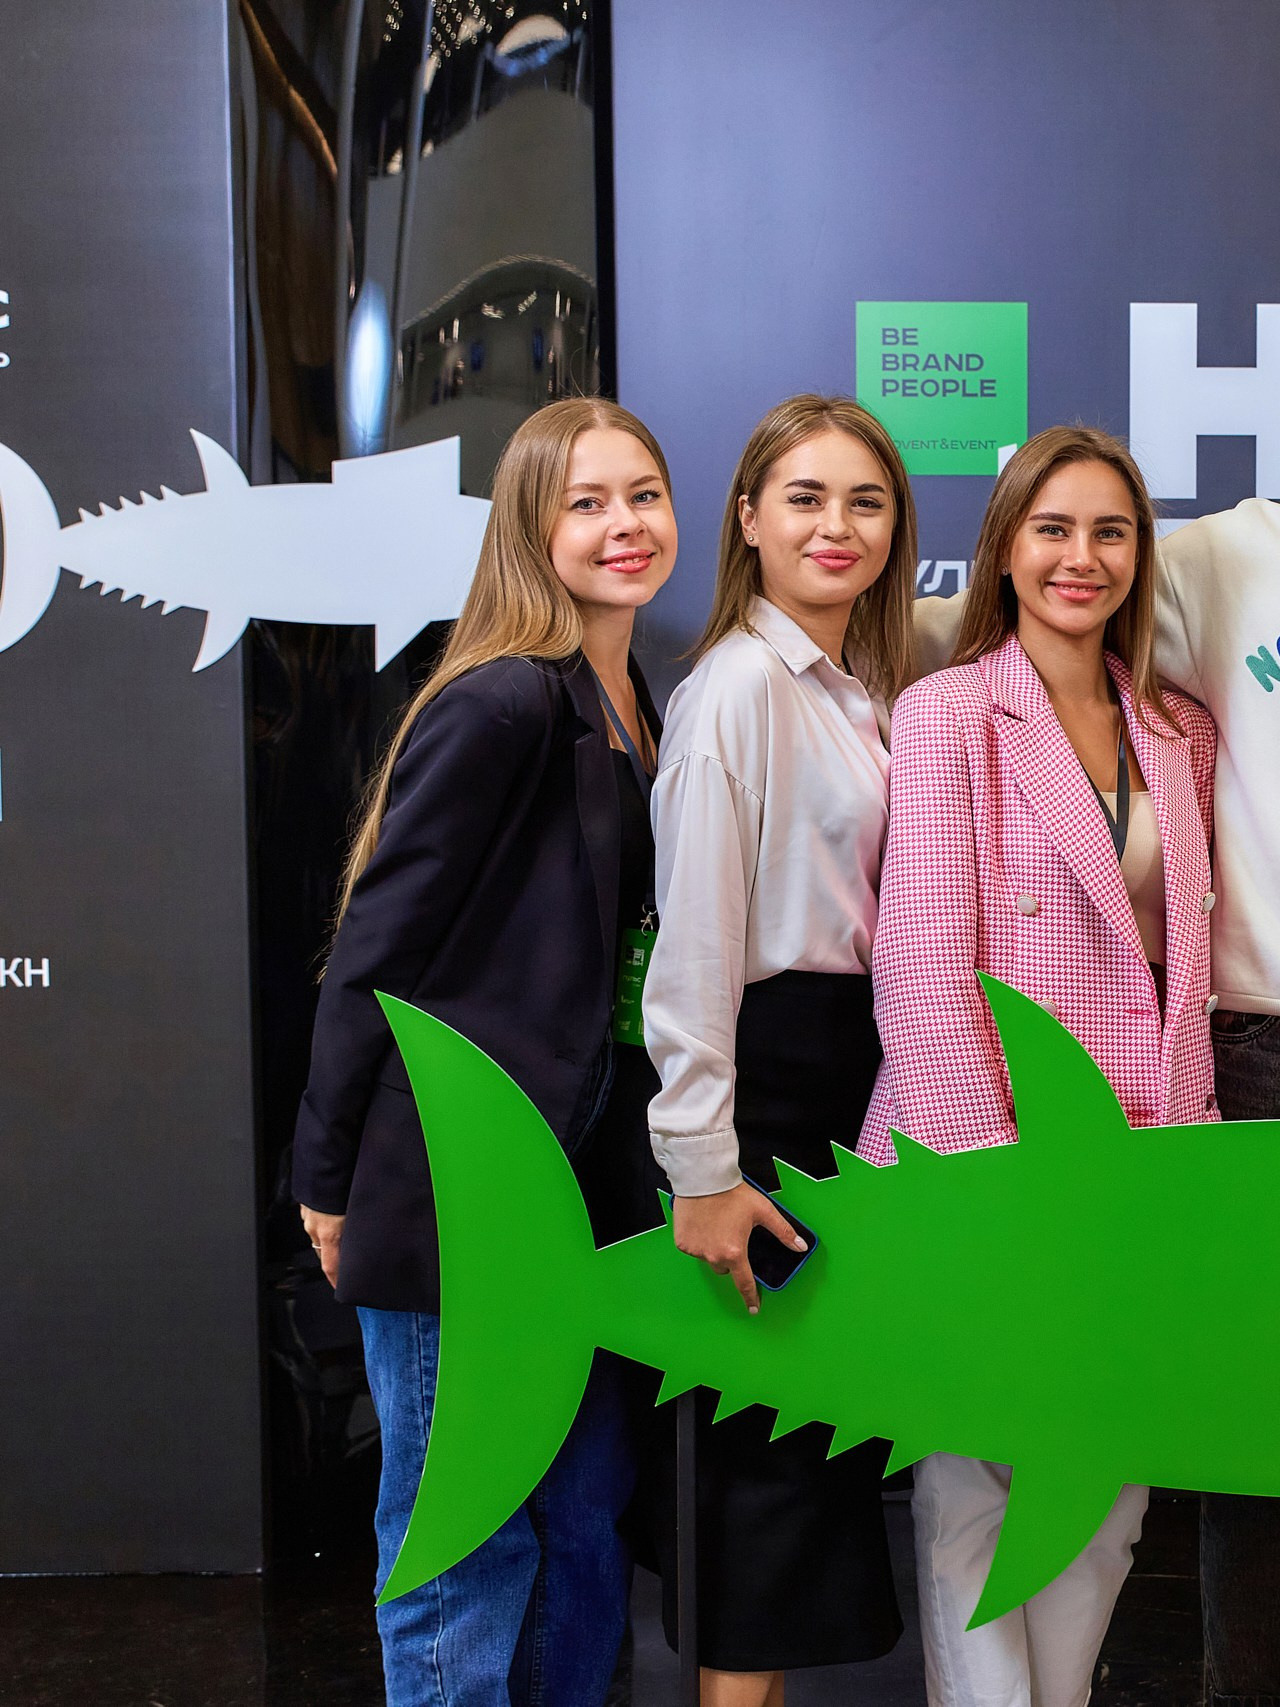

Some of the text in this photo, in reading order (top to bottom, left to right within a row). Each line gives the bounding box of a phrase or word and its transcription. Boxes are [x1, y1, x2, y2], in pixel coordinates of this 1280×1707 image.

[881, 328, 919, 346] BE
[881, 353, 985, 372] BRAND
[881, 379, 997, 398] PEOPLE
[893, 438, 997, 450] DVENT&EVENT
